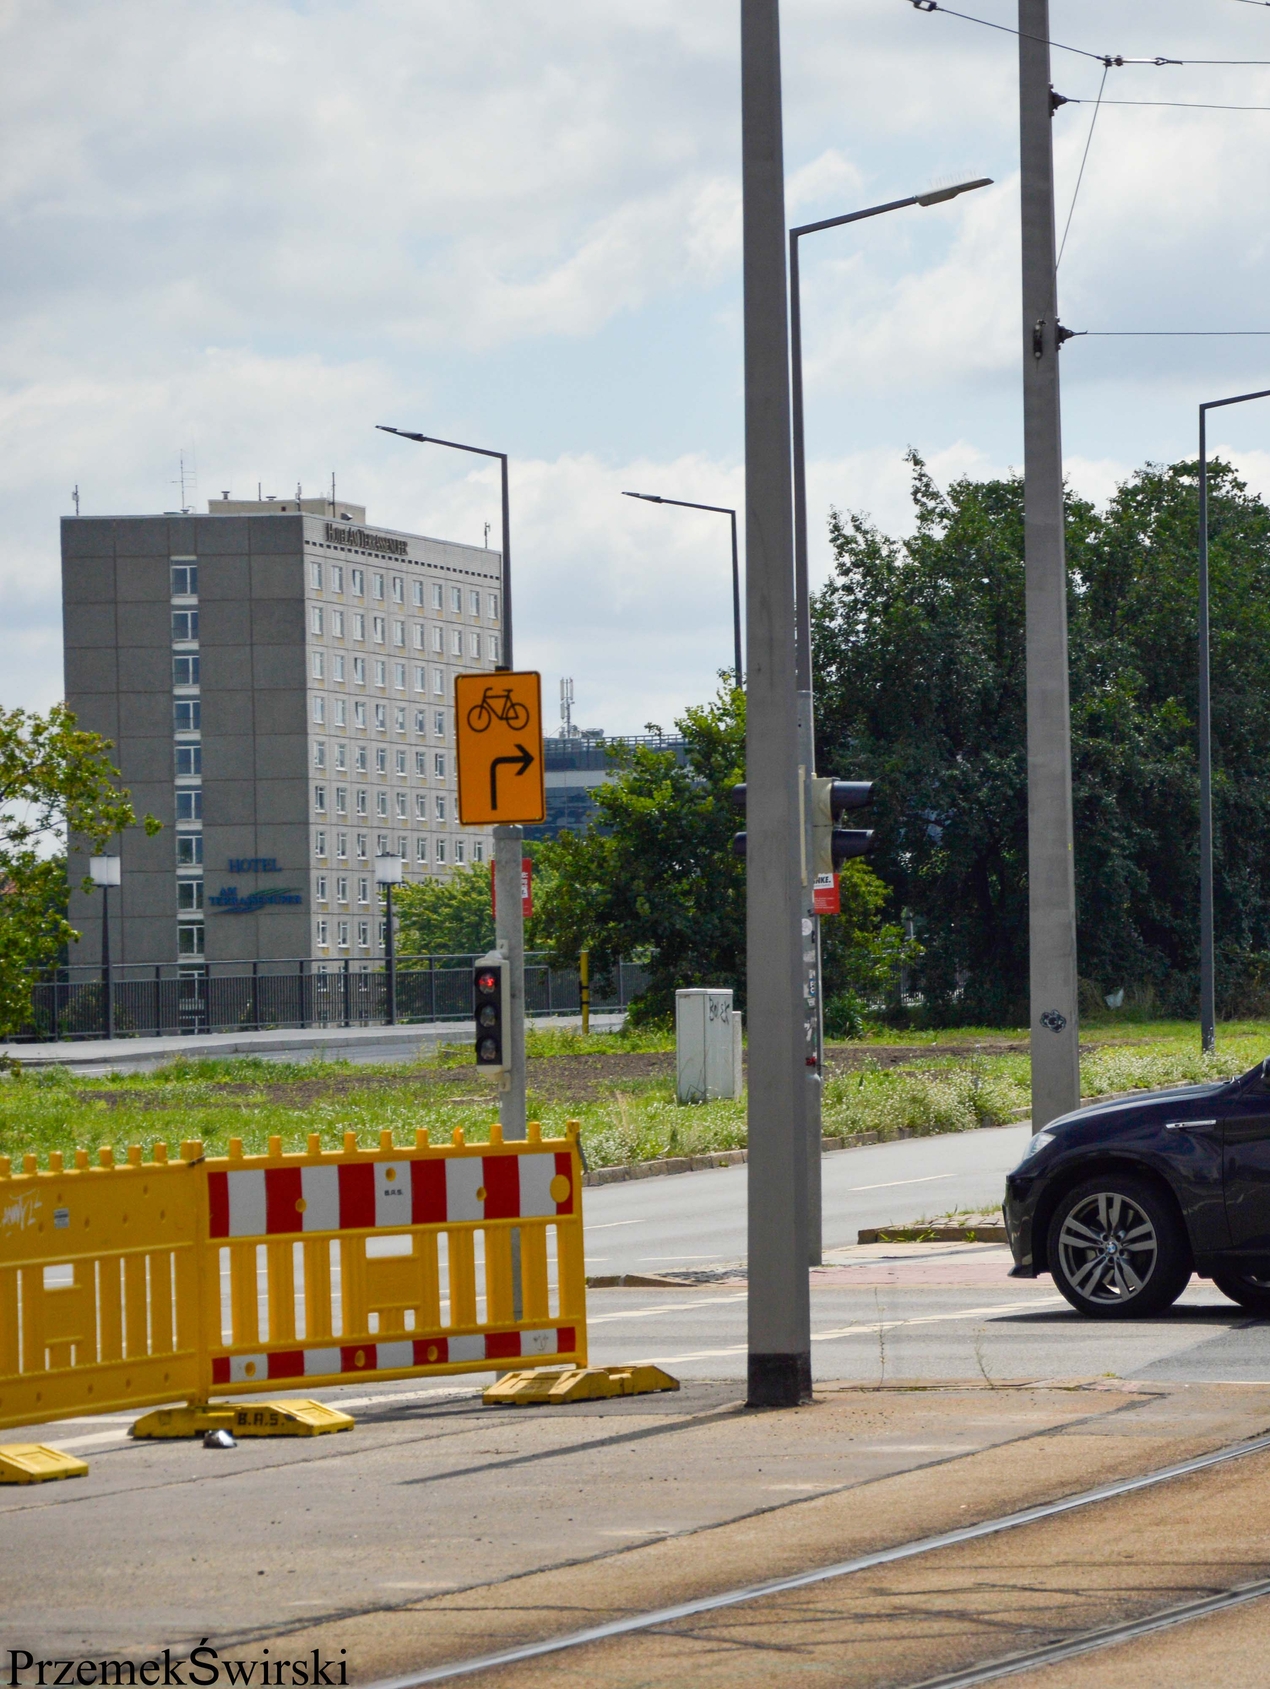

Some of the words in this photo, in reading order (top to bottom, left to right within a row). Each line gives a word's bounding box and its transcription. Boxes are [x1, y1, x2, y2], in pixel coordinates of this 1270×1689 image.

[227, 857, 283, 873] HOTEL
[219, 886, 237, 897] AM
[237, 1412, 285, 1426] B.A.S.
